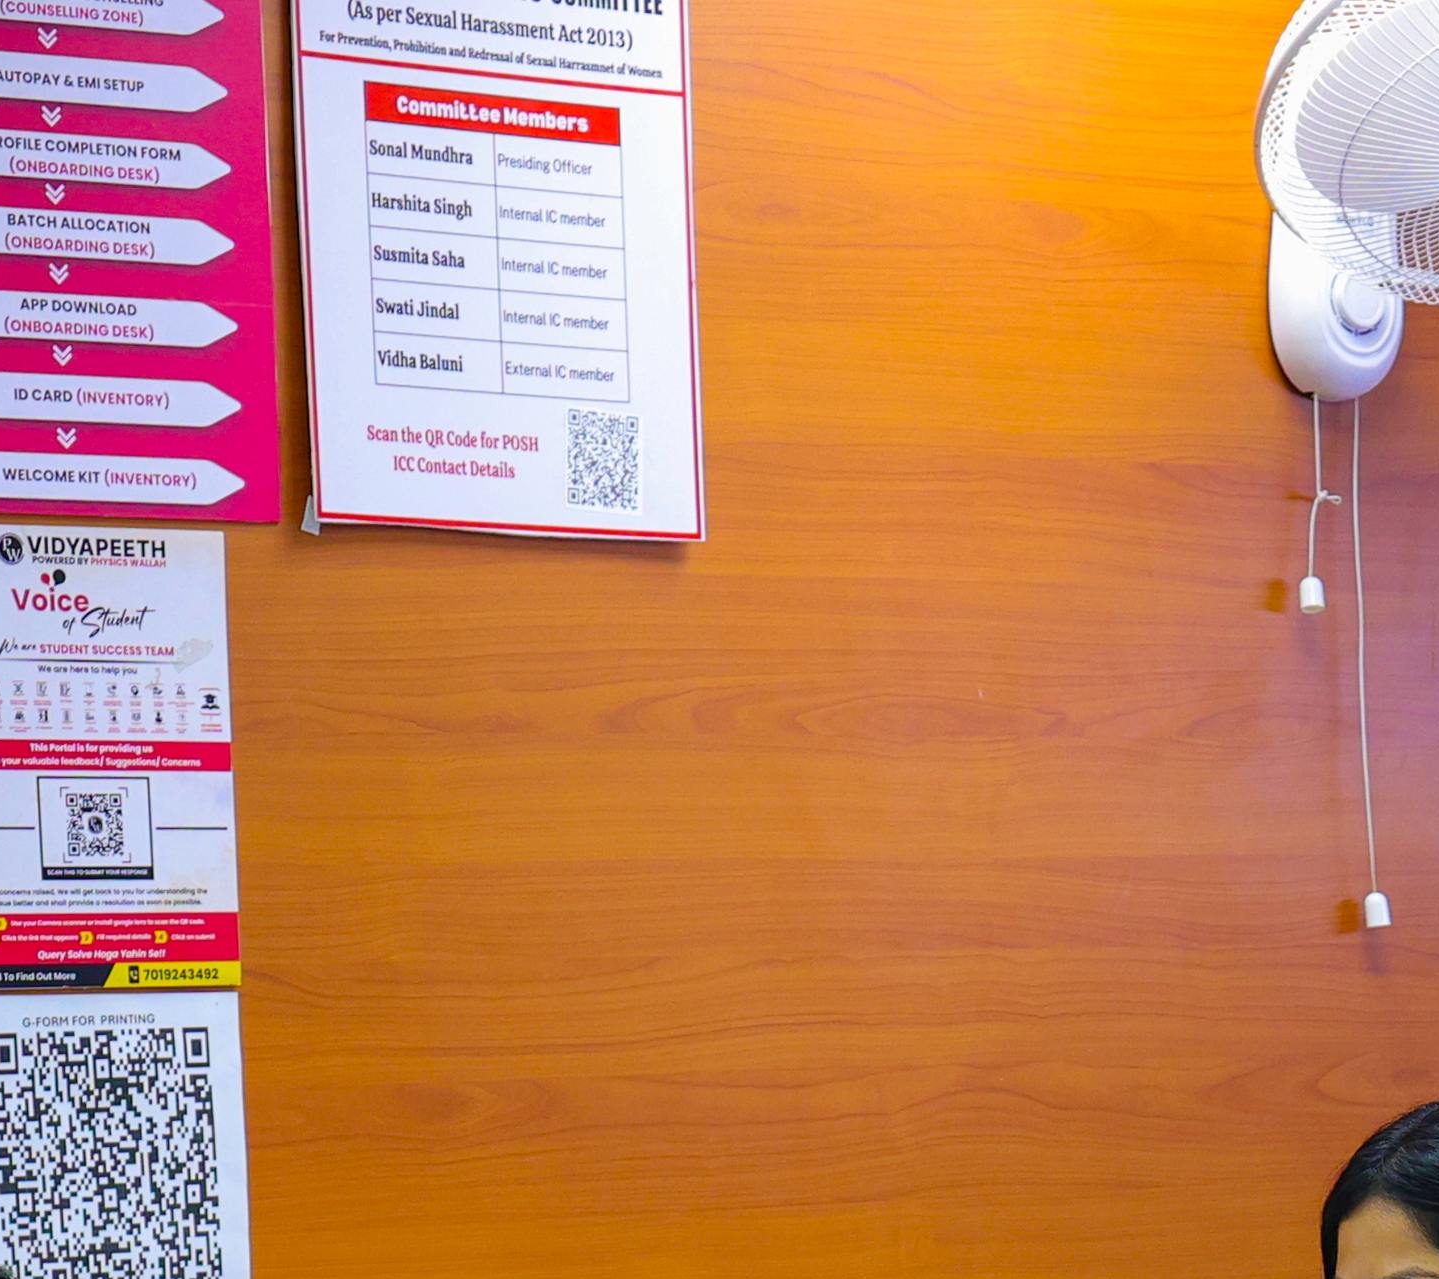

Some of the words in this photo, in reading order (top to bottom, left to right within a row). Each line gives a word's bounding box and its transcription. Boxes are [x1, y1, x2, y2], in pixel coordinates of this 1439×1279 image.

[1, 0, 99, 20] (COUNSELLING
[102, 10, 143, 26] ZONE)
[348, 0, 373, 21] (As
[376, 8, 400, 25] per
[405, 7, 457, 29] Sexual
[462, 14, 555, 40] Harassment
[559, 25, 582, 44] Act
[586, 27, 632, 51] 2013)
[64, 75, 73, 87] &
[77, 76, 100, 89] EMI
[104, 78, 144, 93] SETUP
[396, 96, 500, 124] Committee
[504, 104, 589, 132] Members
[45, 139, 137, 157] COMPLETION
[141, 146, 181, 161] FORM
[370, 140, 407, 158] Sonal
[411, 145, 473, 165] Mundhra
[10, 157, 114, 178] (ONBOARDING
[118, 167, 159, 183] DESK)
[498, 153, 550, 174] Presiding
[553, 161, 592, 175] Officer
[372, 192, 430, 212] Harshita
[434, 198, 472, 220] Singh
[499, 205, 542, 222] Internal
[546, 210, 558, 223] IC
[560, 213, 605, 227] member
[7, 214, 57, 228] BATCH
[61, 217, 150, 234] ALLOCATION
[5, 233, 110, 254] (ONBOARDING
[113, 242, 155, 259] DESK)
[374, 245, 428, 265] Susmita
[432, 250, 465, 268] Saha
[502, 258, 544, 273] Internal
[547, 262, 559, 275] IC
[562, 265, 607, 279] member
[20, 299, 49, 310] APP
[52, 300, 136, 316] DOWNLOAD
[376, 298, 414, 316] Swati
[417, 301, 459, 320] Jindal
[4, 316, 109, 336] (ONBOARDING
[112, 325, 154, 341] DESK)
[503, 310, 547, 326] Internal
[549, 313, 561, 327] IC
[564, 317, 609, 331] member
[378, 350, 416, 368] Vidha
[420, 355, 462, 372] Baluni
[505, 362, 552, 377] External
[555, 365, 566, 378] IC
[569, 368, 614, 382] member
[14, 389, 28, 400] ID
[32, 389, 72, 402] CARD
[77, 390, 169, 409] (INVENTORY)
[367, 425, 398, 442] Scan
[401, 426, 422, 444] the
[425, 430, 443, 448] QR
[447, 431, 478, 447] Code
[481, 431, 499, 449] for
[502, 435, 539, 452] POSH
[394, 456, 414, 471] ICC
[418, 458, 467, 475] Contact
[470, 460, 515, 478] Details
[3, 468, 75, 482] WELCOME
[79, 471, 99, 482] KIT
[104, 472, 197, 490] (INVENTORY)
[27, 535, 166, 558] VIDYAPEETH
[32, 556, 75, 564] POWERED
[91, 558, 127, 566] PHYSICS
[130, 559, 166, 567] WALLAH
[11, 587, 89, 612] Voice
[63, 617, 77, 635] of
[81, 606, 155, 638] Student
[40, 644, 90, 654] STUDENT
[92, 645, 141, 655] SUCCESS
[144, 646, 174, 656] TEAM
[74, 665, 89, 673] here
[102, 665, 120, 675] help
[123, 667, 137, 675] you
[4, 972, 14, 981] To
[16, 972, 34, 981] Find
[36, 972, 52, 980] Out
[54, 971, 76, 981] More
[143, 969, 218, 981] 7019243492
[22, 1016, 69, 1028] G-FORM
[71, 1015, 95, 1026] FOR
[100, 1013, 155, 1025] PRINTING
